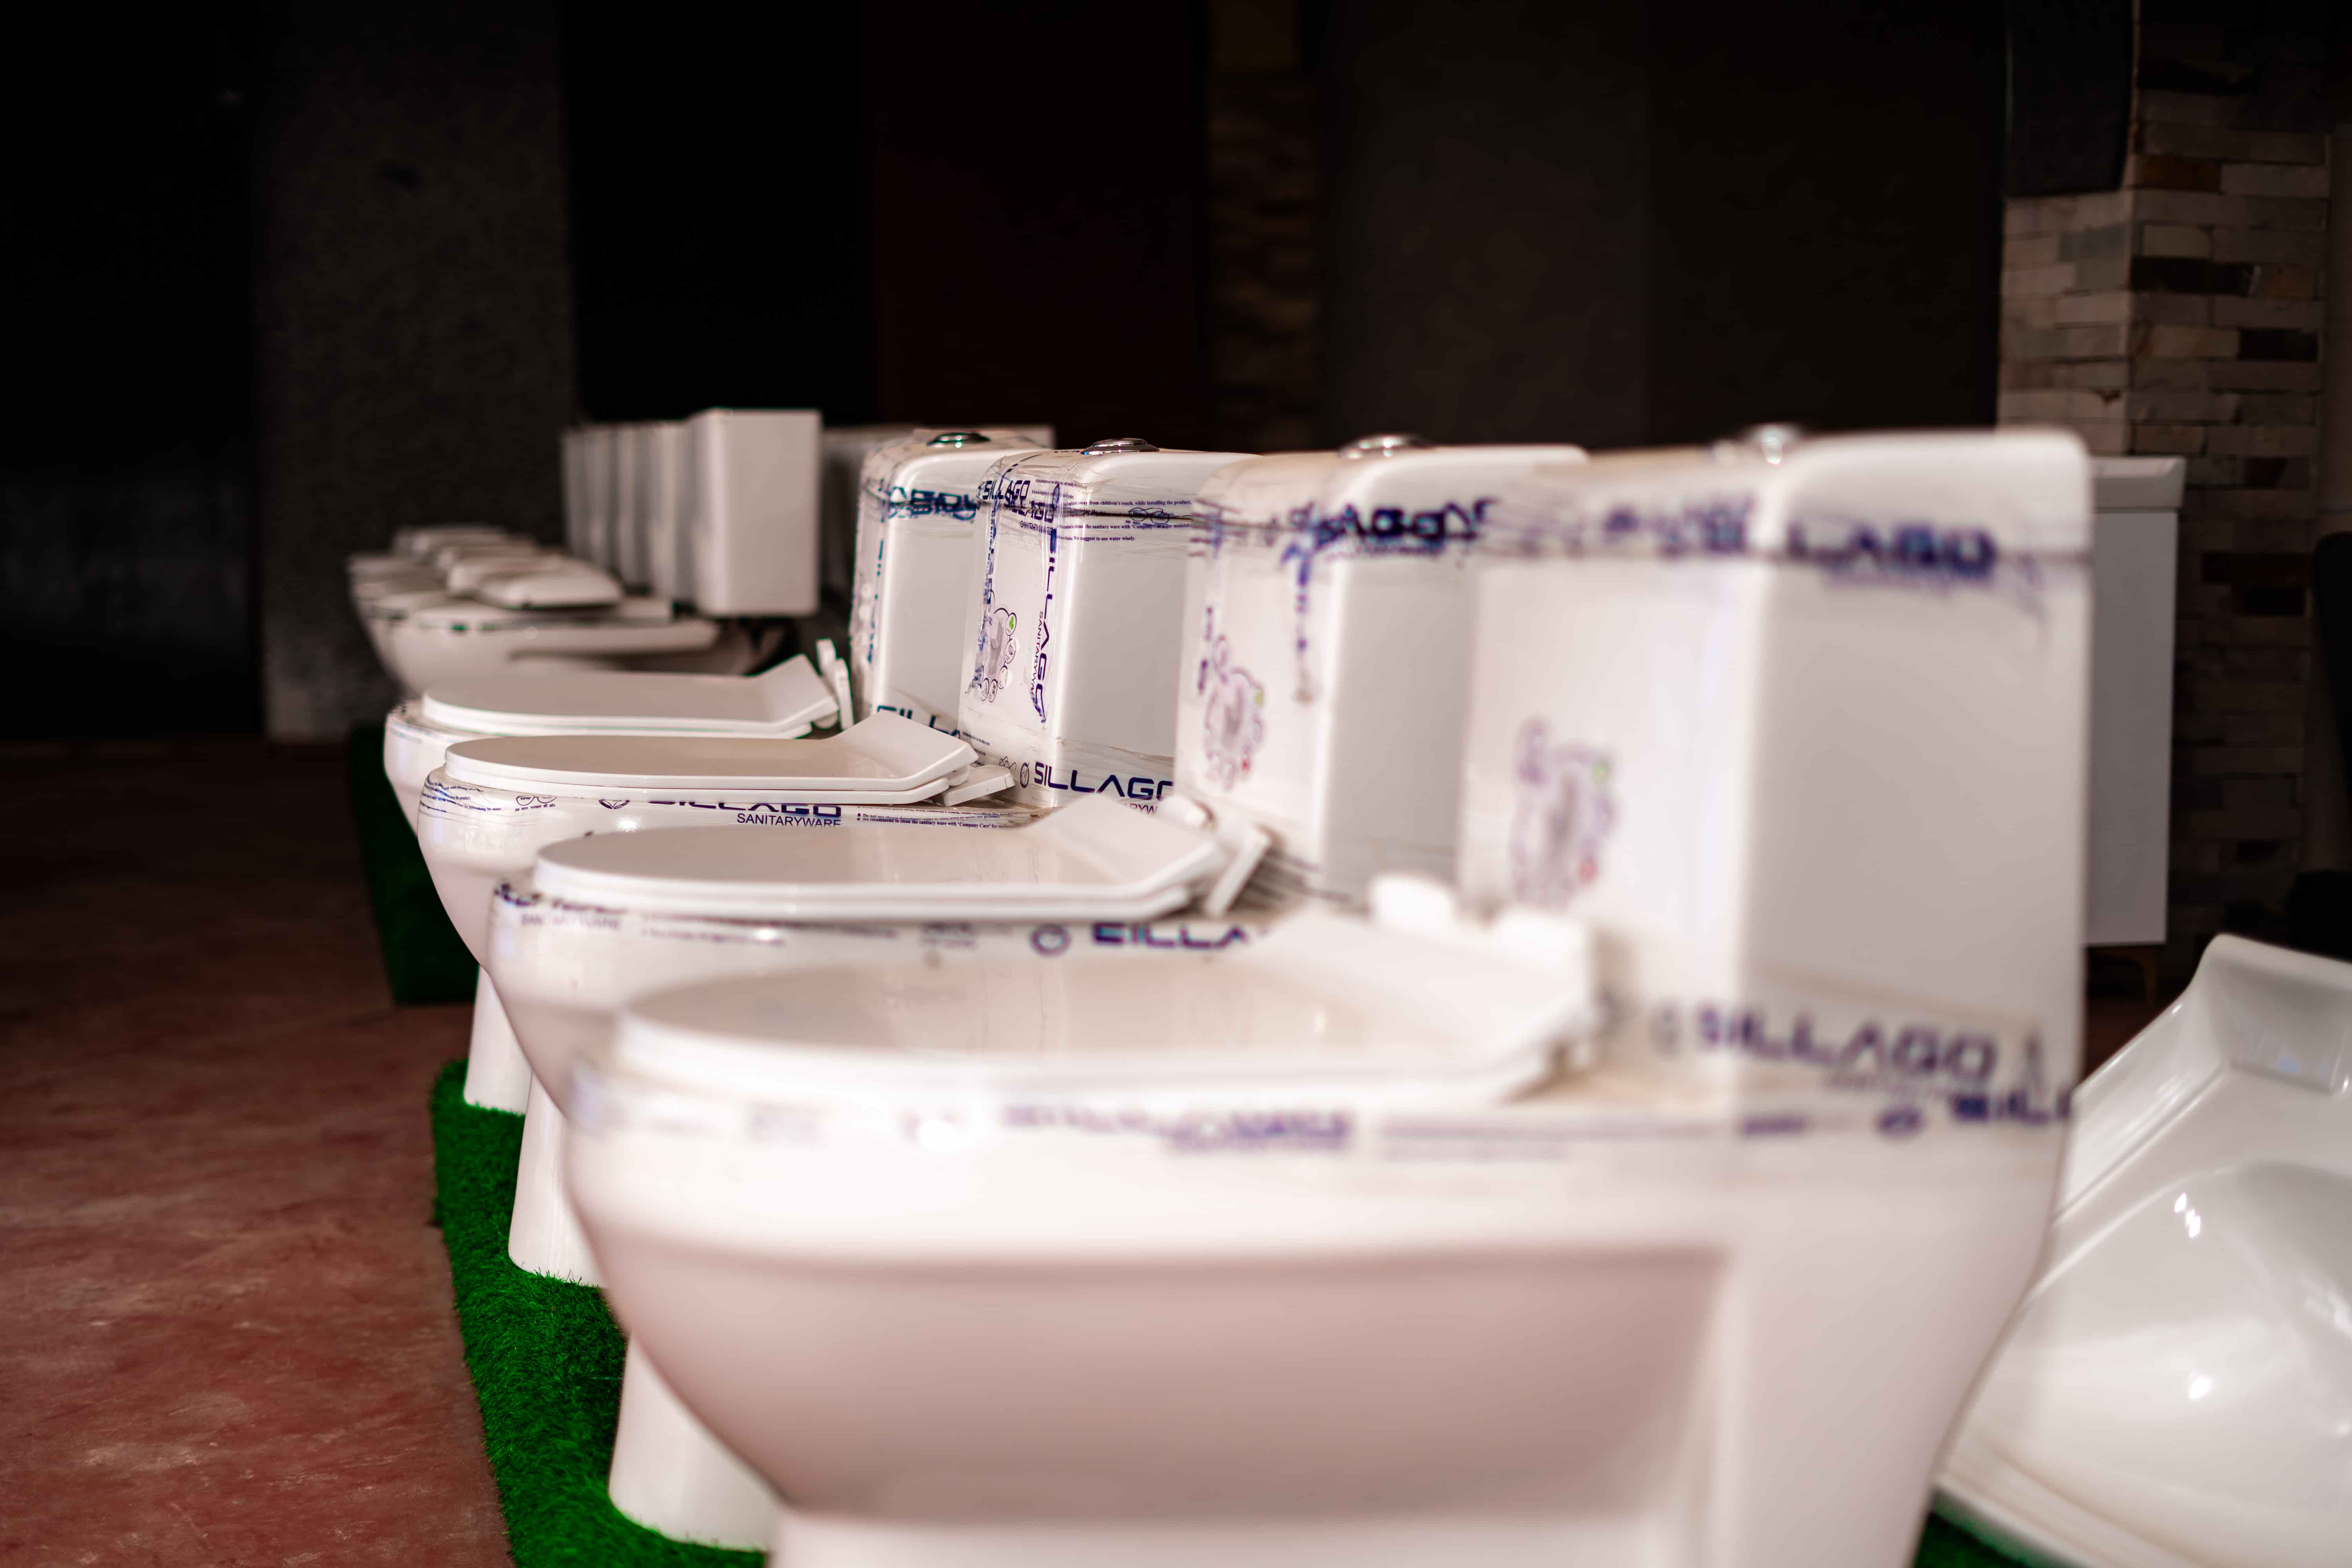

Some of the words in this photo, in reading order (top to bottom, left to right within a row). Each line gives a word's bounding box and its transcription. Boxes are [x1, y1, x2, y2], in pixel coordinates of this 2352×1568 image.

[1035, 528, 1058, 722] ILLAGO
[1030, 611, 1044, 717] SANITARYWA
[647, 800, 841, 817] LLAGO
[737, 813, 841, 827] SANITARYWARE
